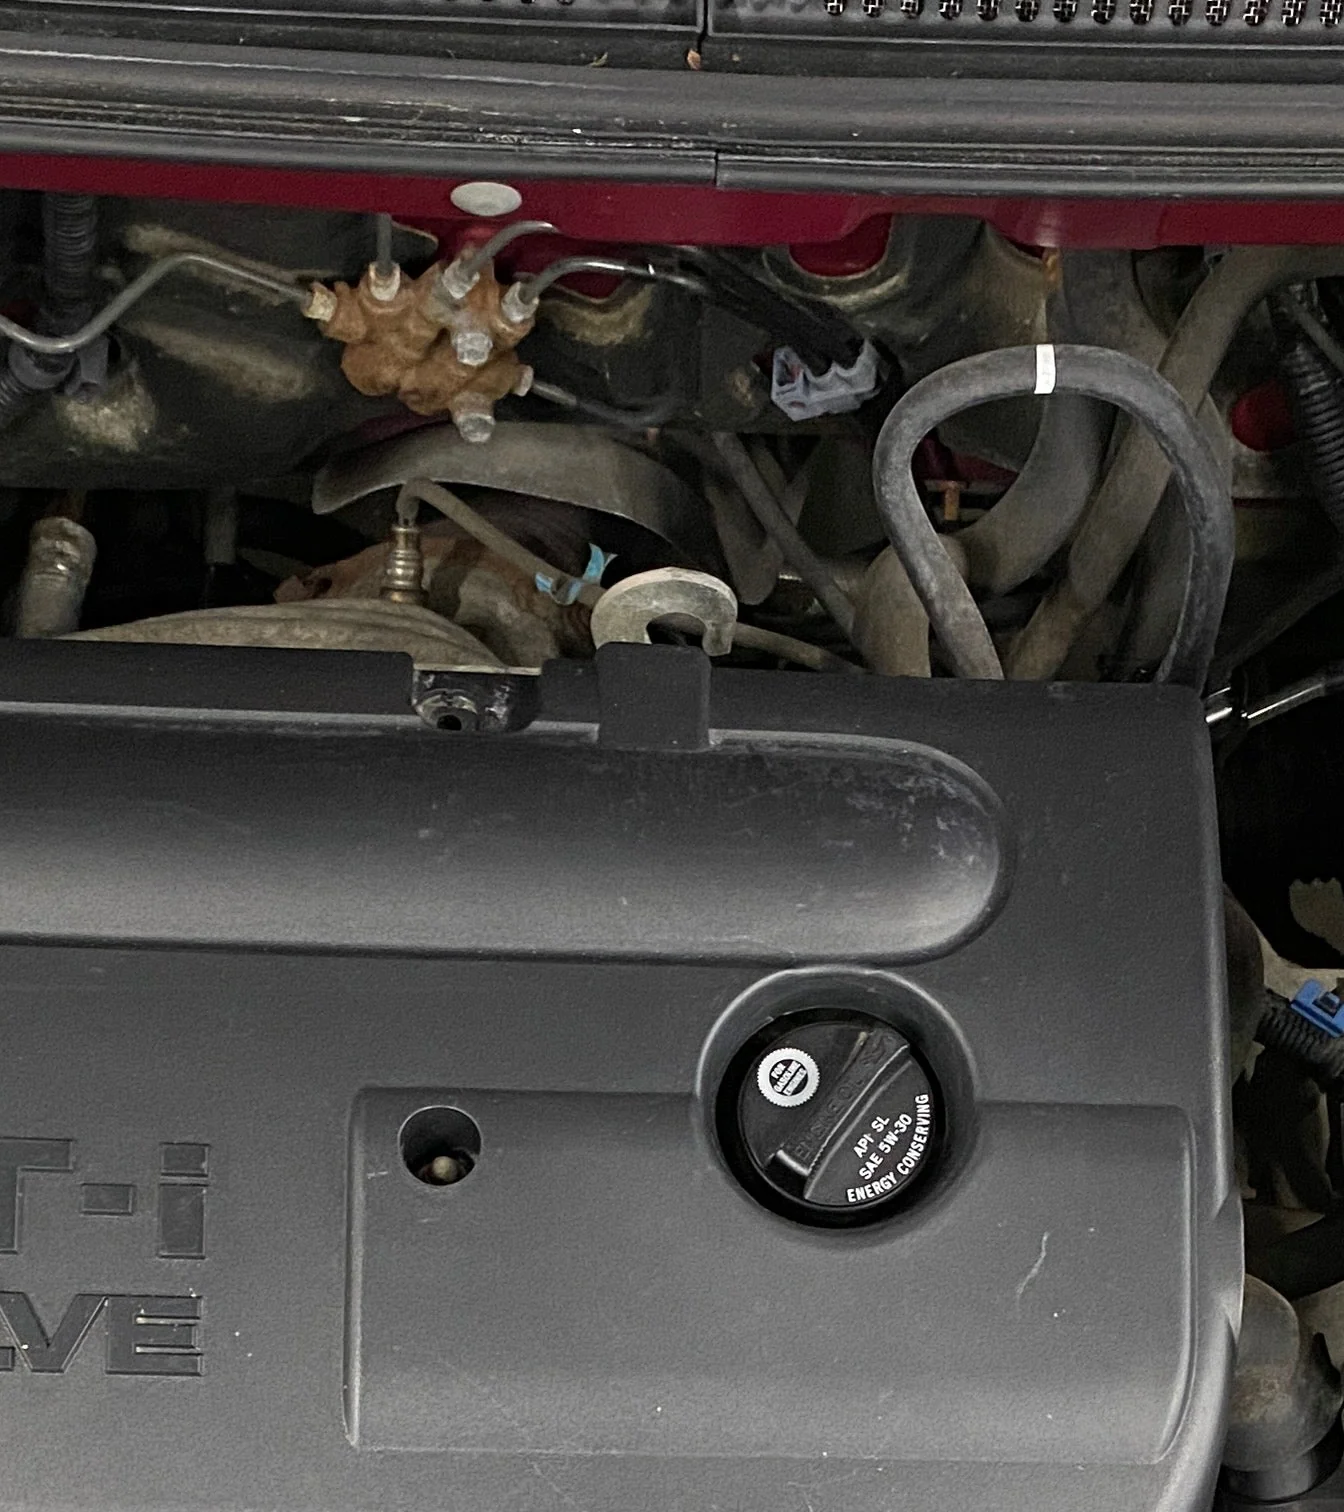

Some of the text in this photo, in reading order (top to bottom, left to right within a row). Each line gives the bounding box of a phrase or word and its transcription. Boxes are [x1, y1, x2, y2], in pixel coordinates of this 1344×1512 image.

[846, 1093, 932, 1204] ENERGY CONSERVING
[852, 1114, 891, 1160] API SL
[858, 1112, 913, 1181] SAE 5W-30
